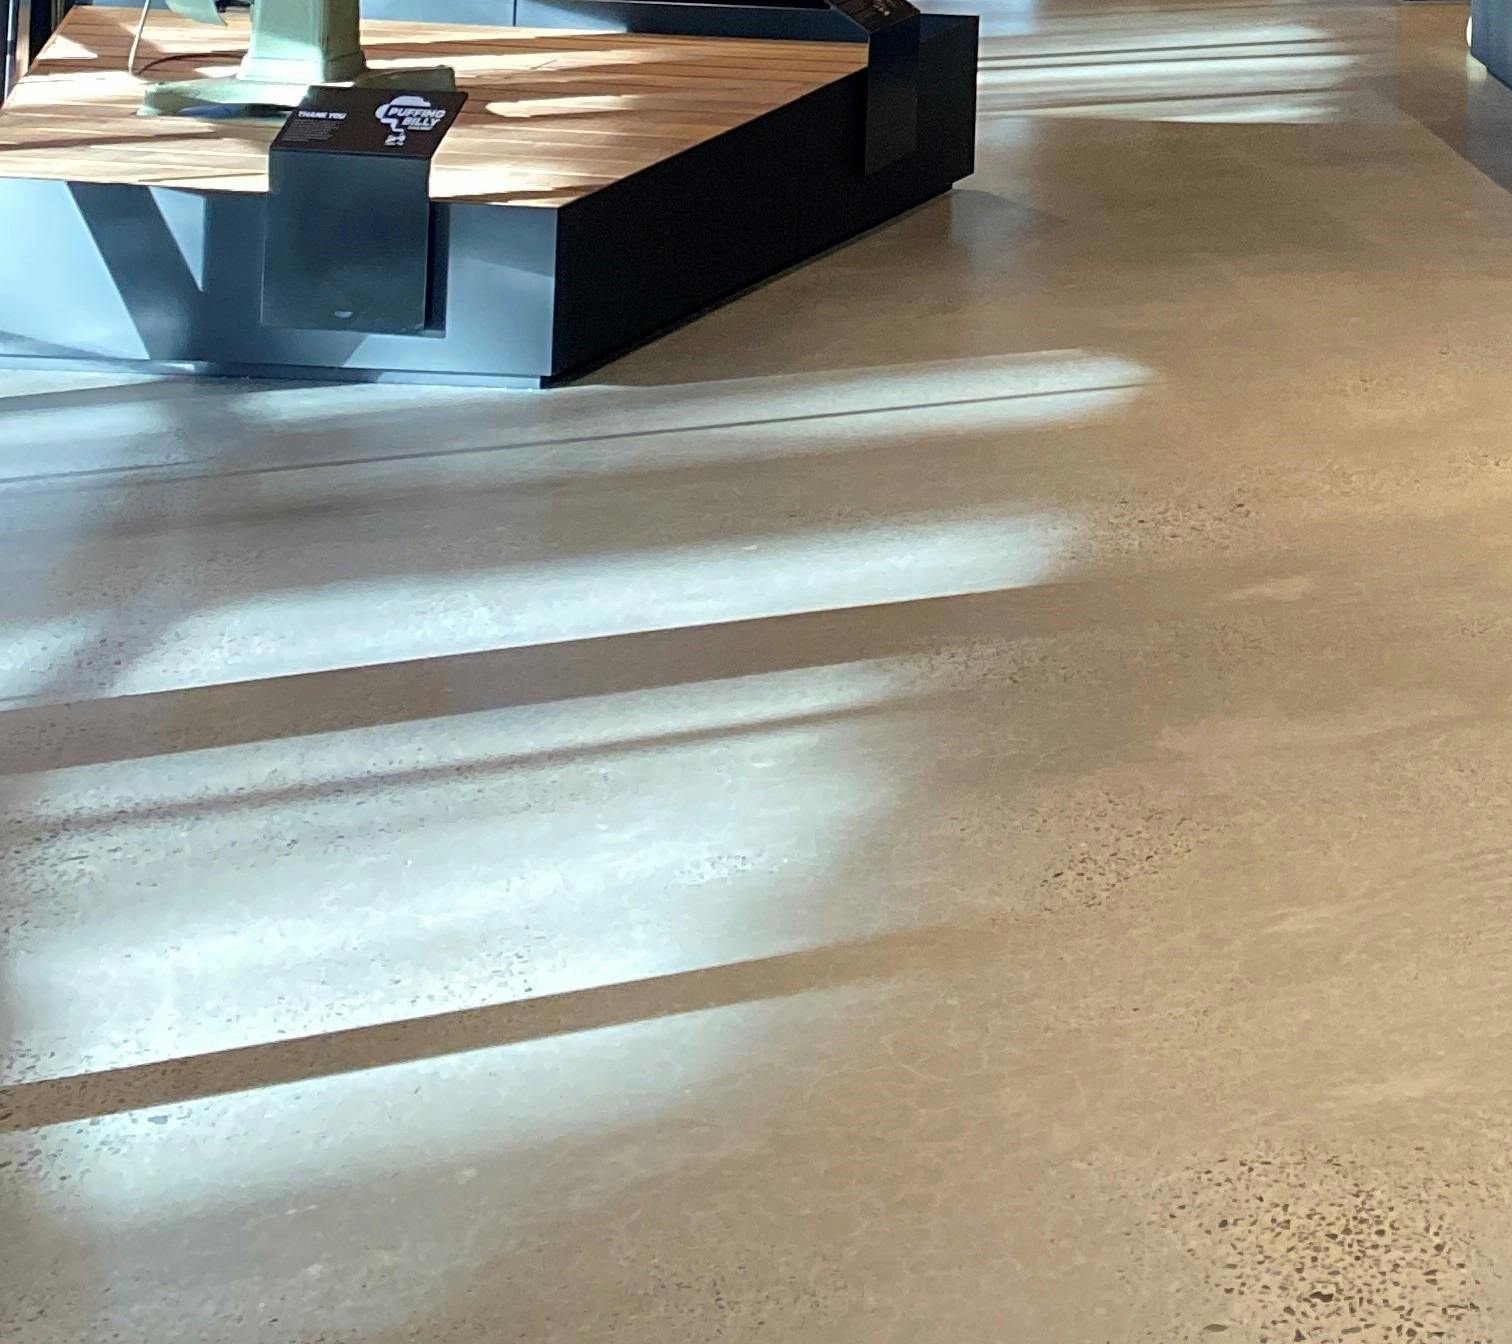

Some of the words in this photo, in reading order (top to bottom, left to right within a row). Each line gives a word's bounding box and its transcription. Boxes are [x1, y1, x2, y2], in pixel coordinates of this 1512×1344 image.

[298, 111, 328, 119] THANK
[328, 112, 347, 120] YOU
[387, 106, 447, 118] PUFFING
[401, 116, 441, 127] BILLY
